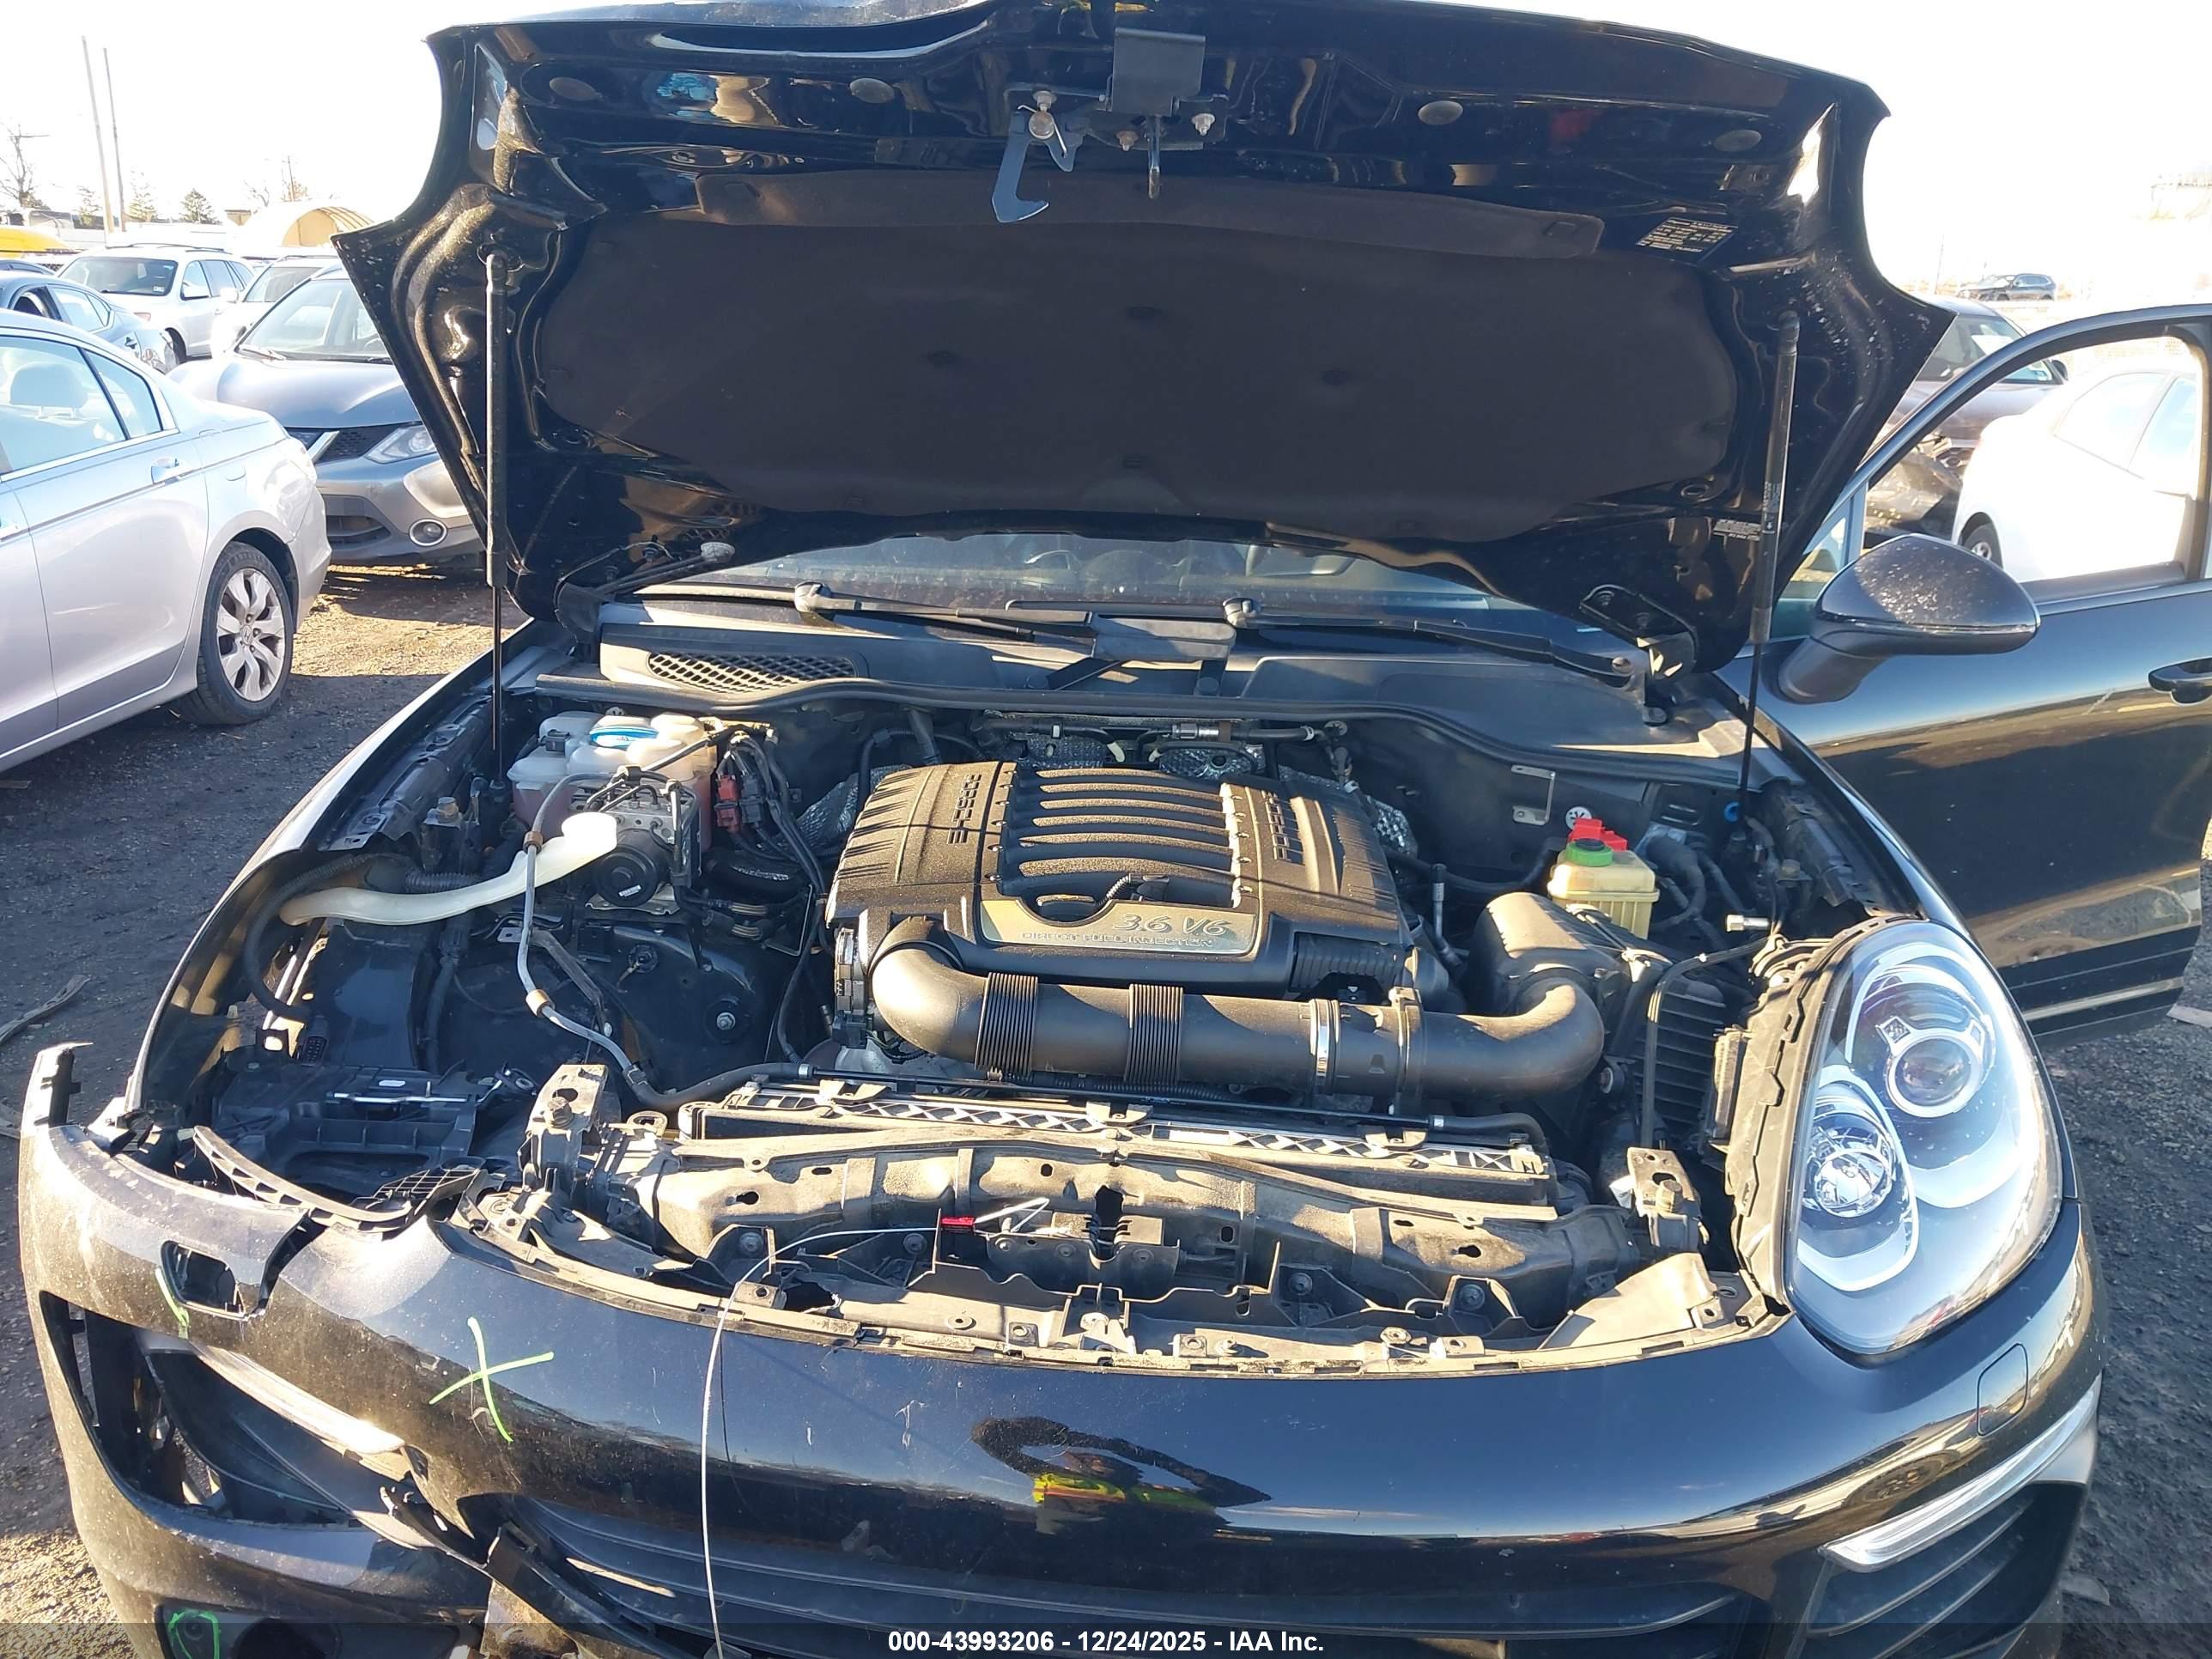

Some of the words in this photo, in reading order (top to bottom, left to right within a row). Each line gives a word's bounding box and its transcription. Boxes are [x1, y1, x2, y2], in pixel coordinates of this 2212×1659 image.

[946, 774, 982, 844] PORSCHE
[1113, 914, 1171, 933] 3.6
[1182, 916, 1232, 936] V6
